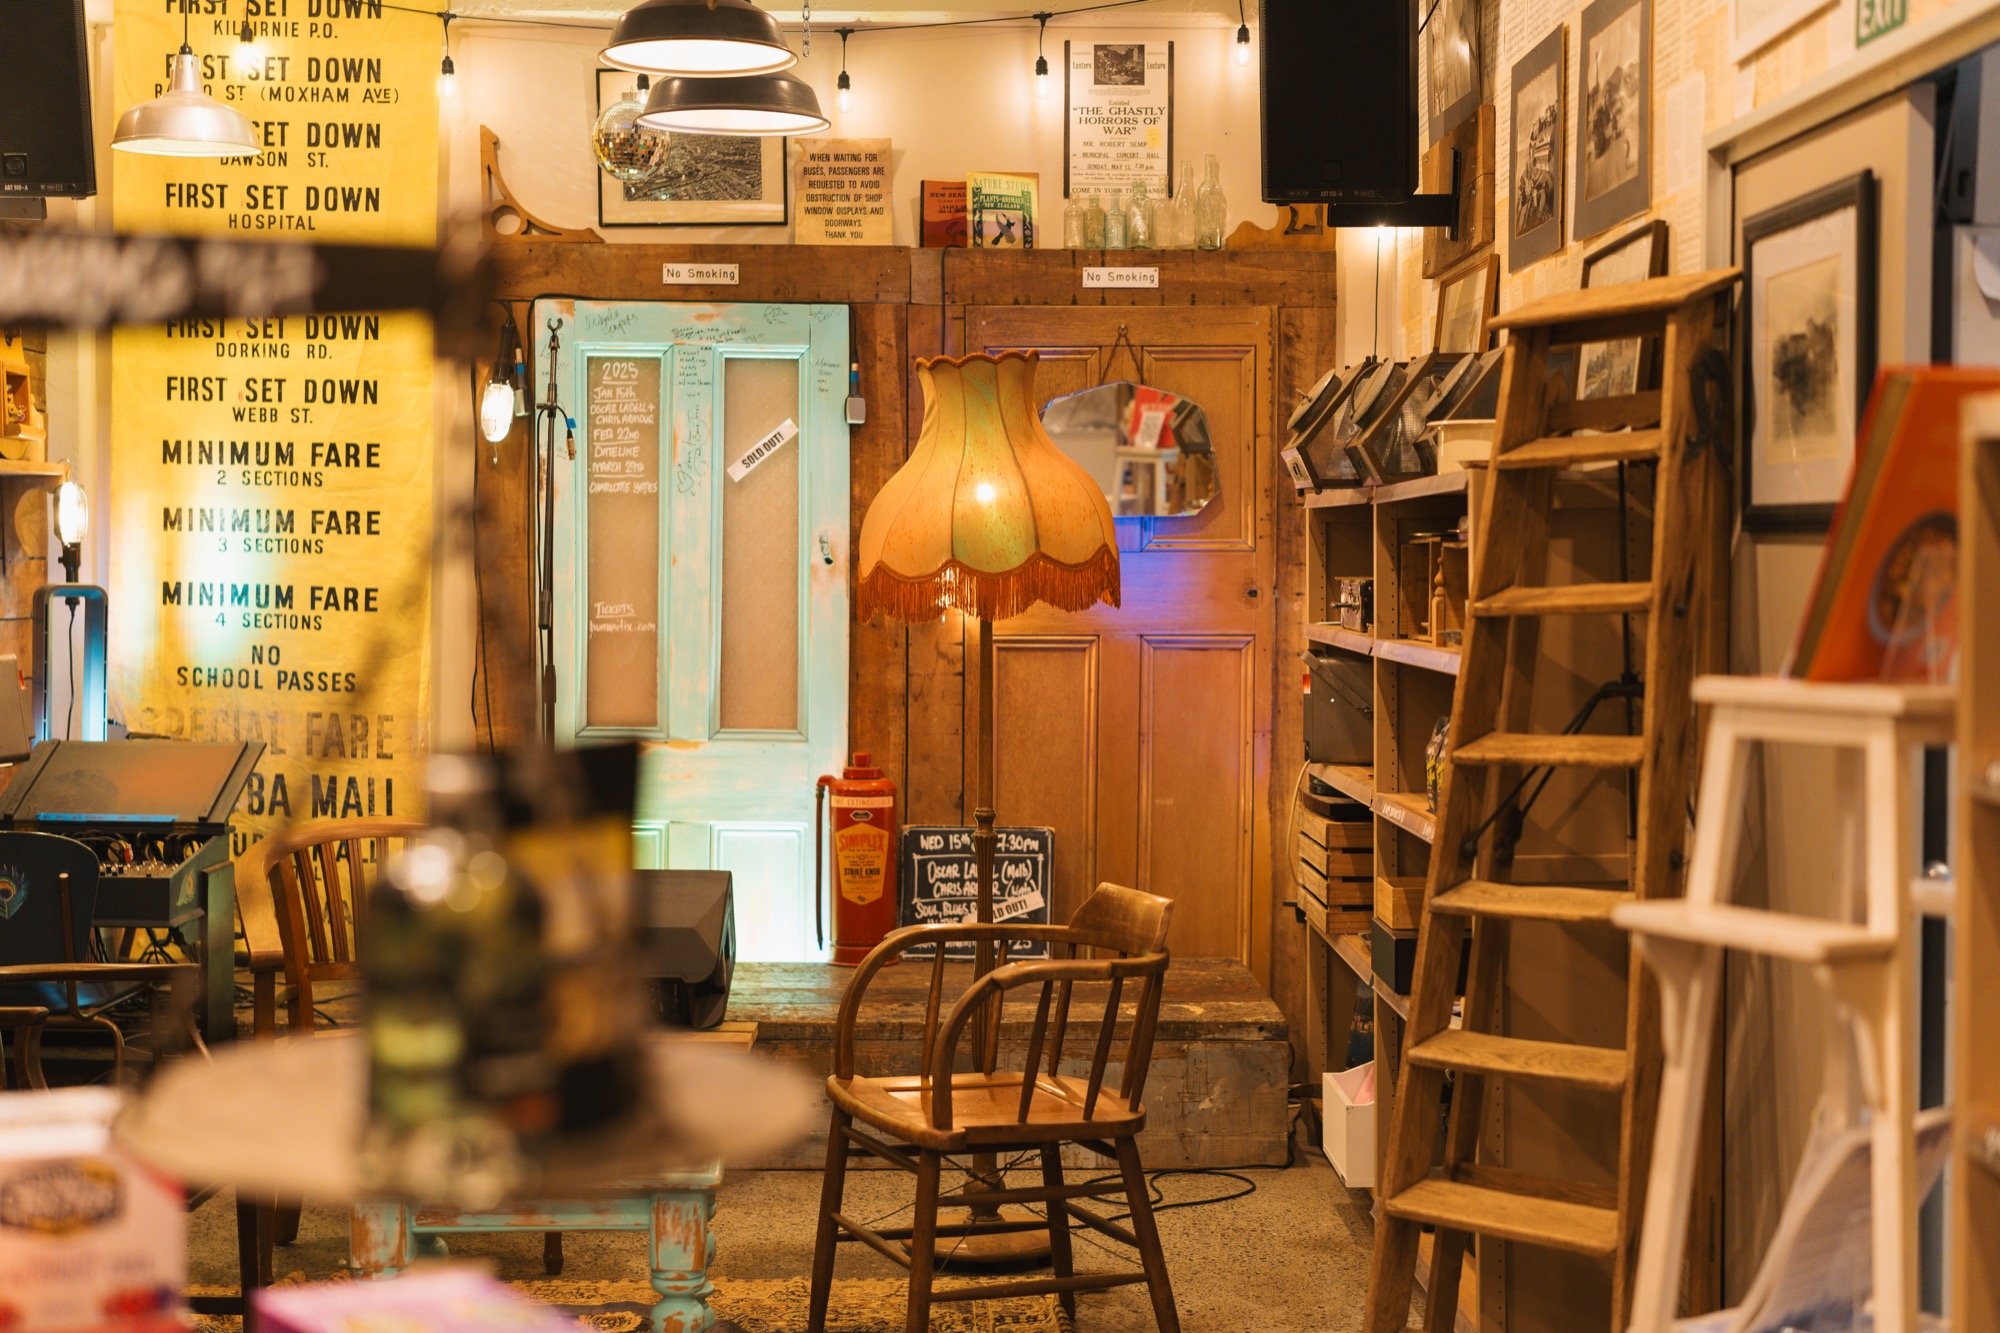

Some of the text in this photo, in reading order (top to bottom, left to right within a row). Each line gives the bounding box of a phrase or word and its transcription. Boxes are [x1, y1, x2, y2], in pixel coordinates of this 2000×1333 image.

[308, 0, 382, 19] DOWN
[214, 20, 338, 39] KILIRNIE P.O.
[165, 53, 229, 80] FST
[308, 57, 381, 83] DOWN
[261, 86, 350, 103] (MOXHAM
[1109, 106, 1166, 115] GHASTLY
[1079, 117, 1160, 125] HORRORS OF
[252, 121, 381, 148] ET DOWN
[220, 152, 329, 168] DAWSON ST.
[809, 153, 878, 162] WHEN WAITING FOR
[803, 166, 885, 176] BUSES, PASSENGERS ARE
[808, 180, 880, 189] REQUESTED TO AVOID
[973, 177, 1031, 192] NATURE STUDY
[165, 183, 380, 212] FIRST SET DOWN
[805, 193, 882, 202] OBSTRUCTION OF SHOP
[804, 207, 884, 215] WINDOW DISPLAYS AND
[229, 214, 316, 231] HOSPITAL
[825, 231, 863, 239] THANK YOU
[667, 268, 735, 281] No Smoking
[1086, 272, 1155, 284] No Smoking
[166, 315, 379, 341] FIRST SET DOWN
[216, 342, 332, 359] DORKING RD.
[602, 362, 639, 380] 2025
[166, 376, 378, 404] FIRST SET DOWN
[232, 407, 313, 424] WEBB ST.
[590, 403, 617, 415] OSCAR
[162, 440, 381, 468] MINIMUM FARE
[741, 431, 784, 469] SOLD OUT!
[217, 470, 323, 487] 2 SECTIONS
[163, 507, 381, 535] MINIMUM FARE
[218, 537, 324, 554] 3 SECTIONS
[162, 581, 379, 613] MINIMUM FARE
[215, 613, 323, 631] 4 SECTIONS
[251, 645, 281, 666] NO
[177, 667, 357, 693] SCHOOL PASSES
[306, 712, 394, 760] FARE
[964, 861, 999, 879] LAL
[963, 881, 1000, 896] ARR
[1005, 899, 1028, 915] OUT!
